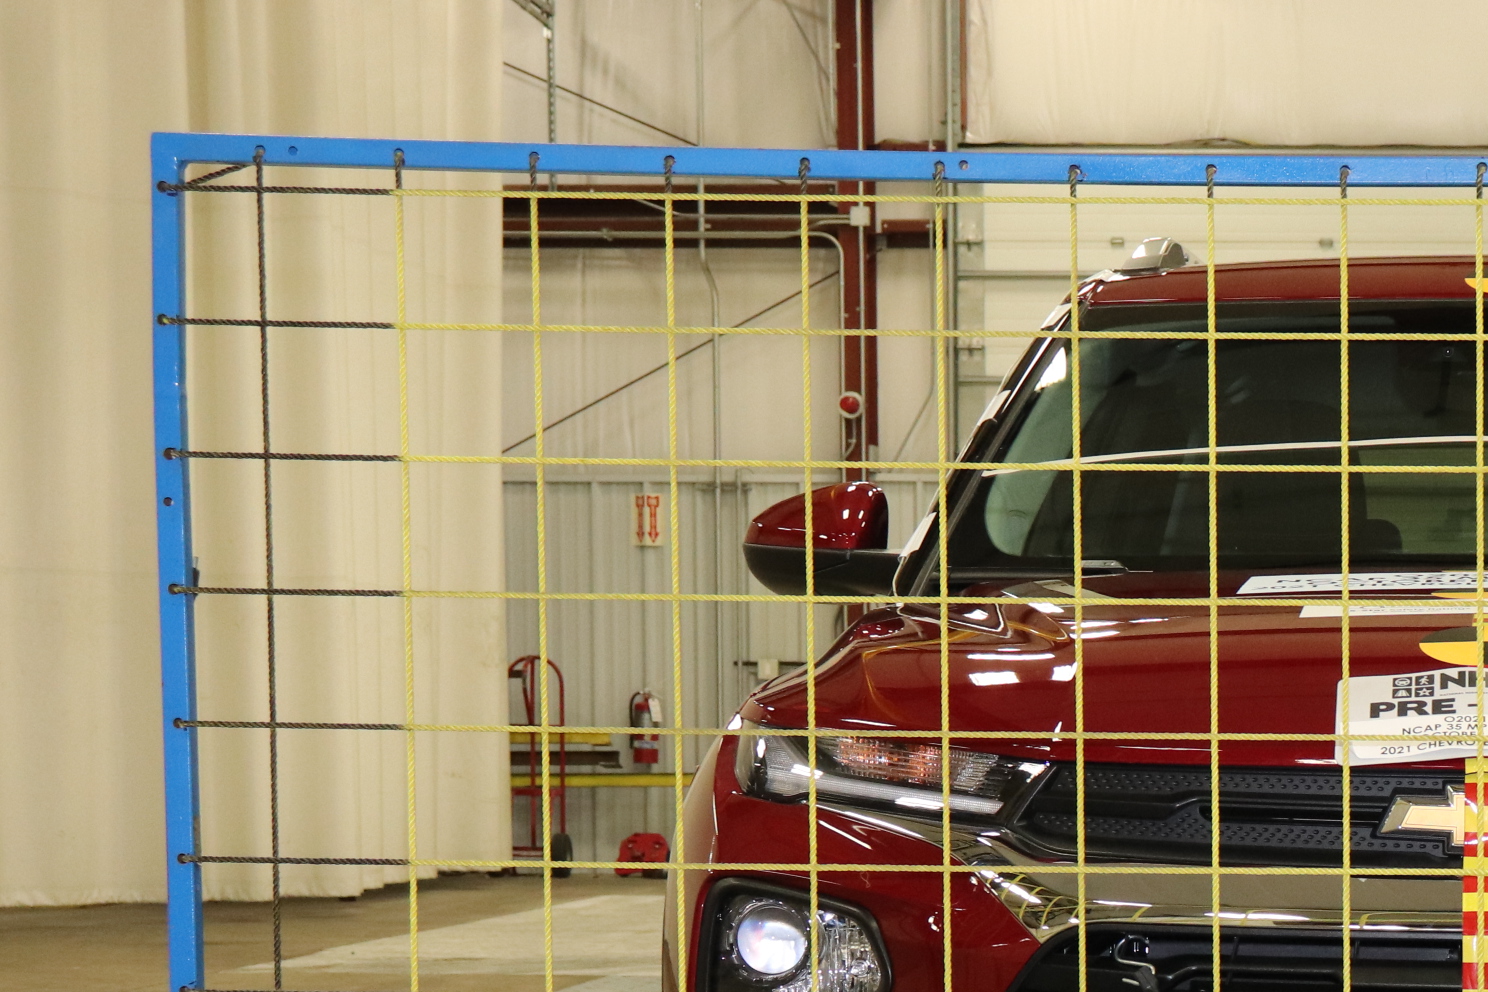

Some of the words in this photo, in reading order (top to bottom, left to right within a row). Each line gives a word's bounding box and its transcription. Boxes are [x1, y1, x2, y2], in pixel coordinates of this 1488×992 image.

[1370, 698, 1455, 718] PRE
[1402, 723, 1441, 735] NCAP
[1380, 745, 1411, 755] 2021
